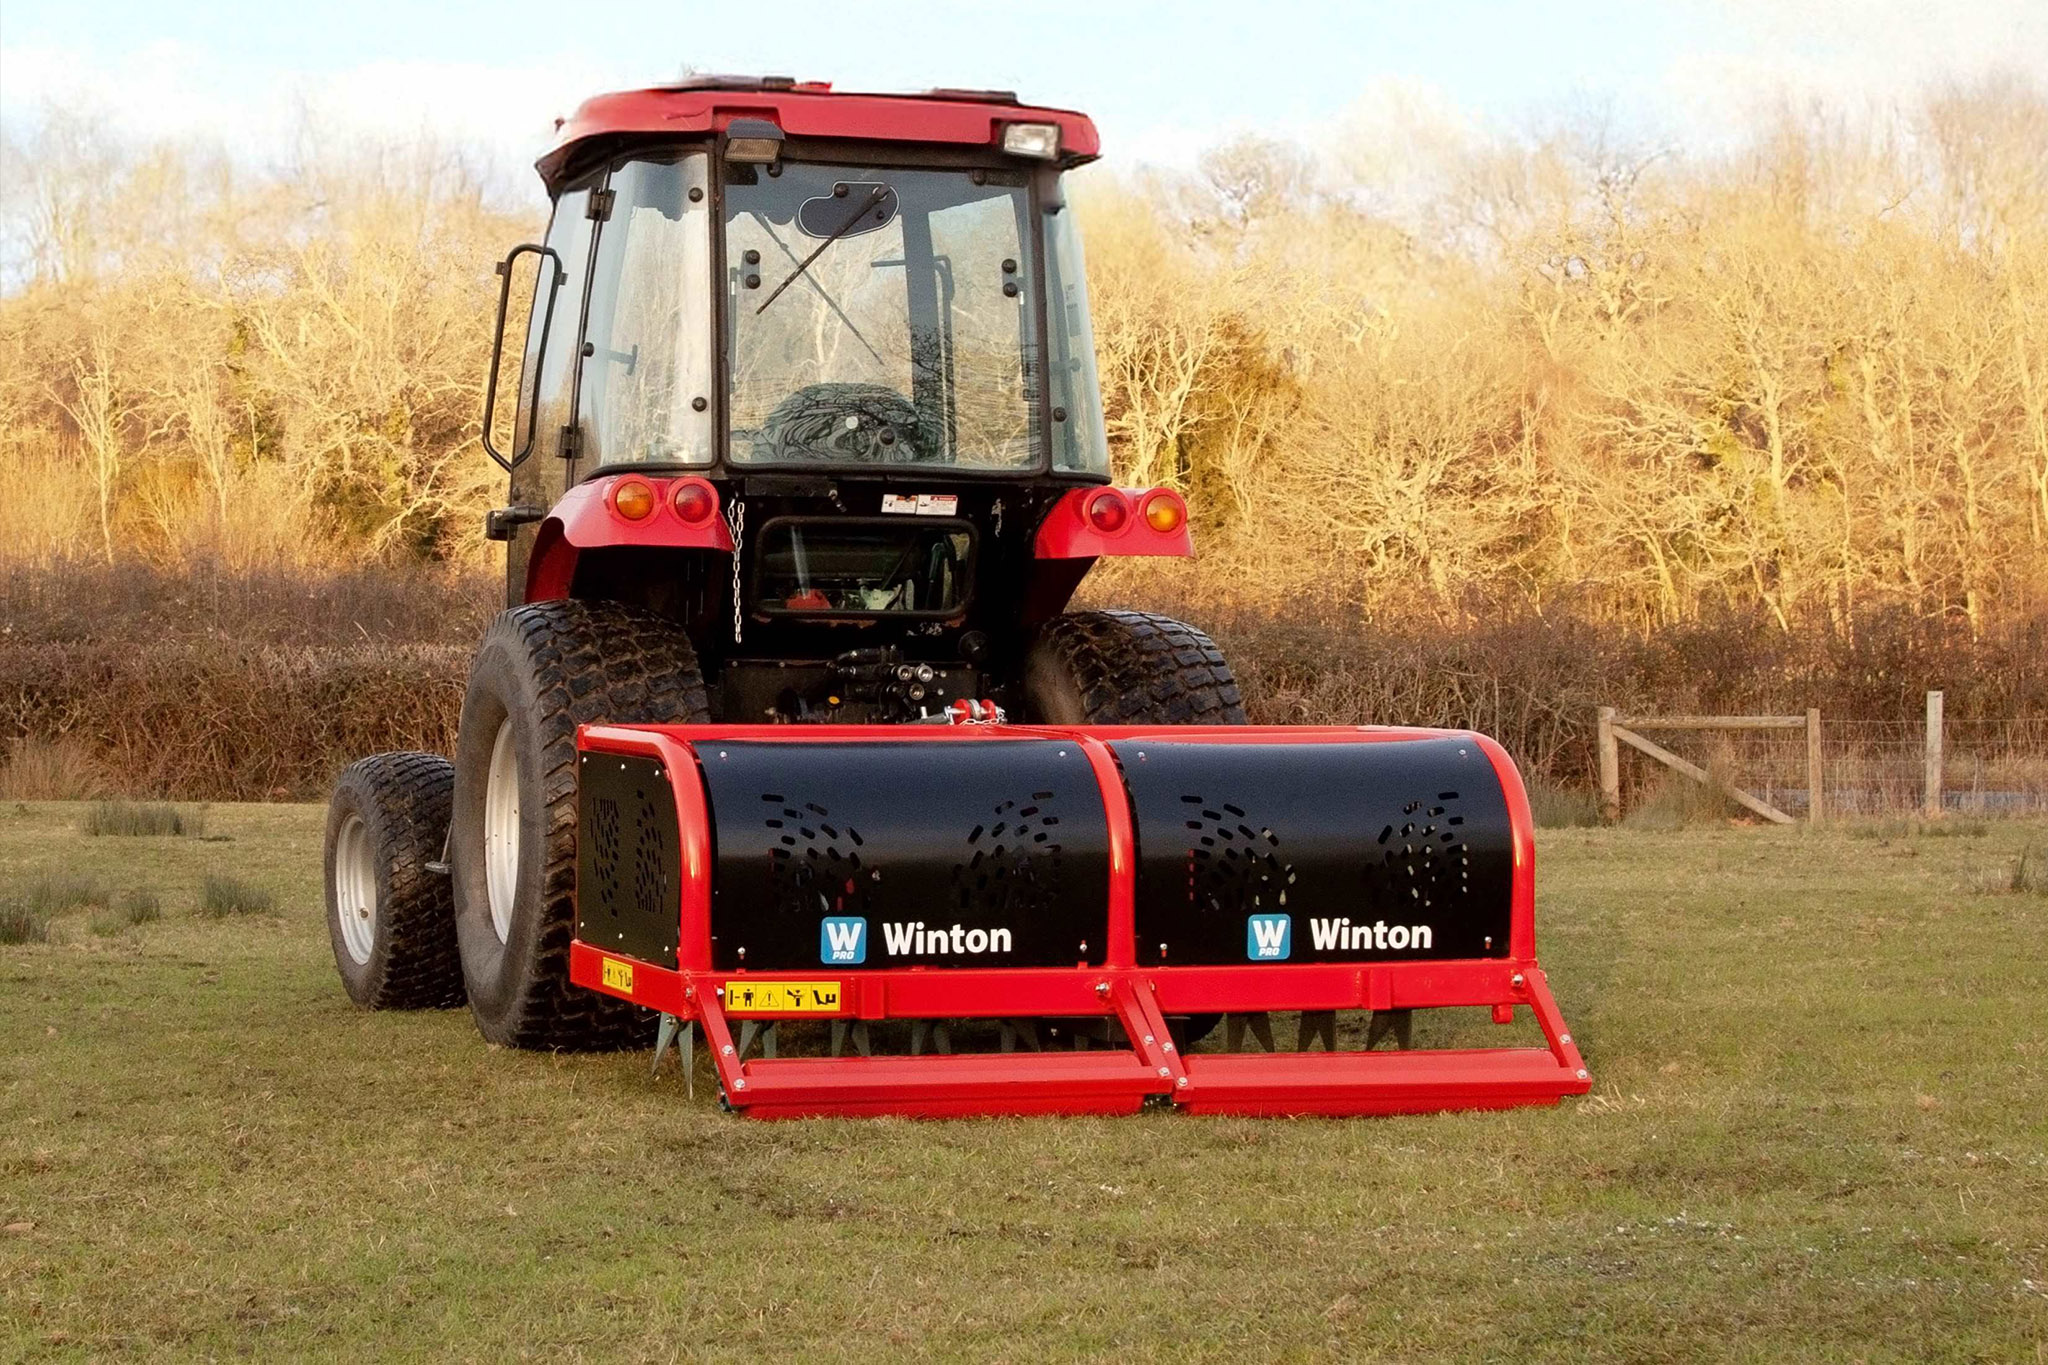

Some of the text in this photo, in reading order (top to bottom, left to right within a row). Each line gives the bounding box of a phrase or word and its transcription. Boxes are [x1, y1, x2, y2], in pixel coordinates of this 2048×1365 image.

[826, 922, 862, 951] W
[882, 921, 1012, 956] Winton
[1253, 919, 1287, 948] W
[1310, 917, 1432, 951] Winton
[832, 951, 855, 960] PRO
[1258, 947, 1280, 957] PRO
